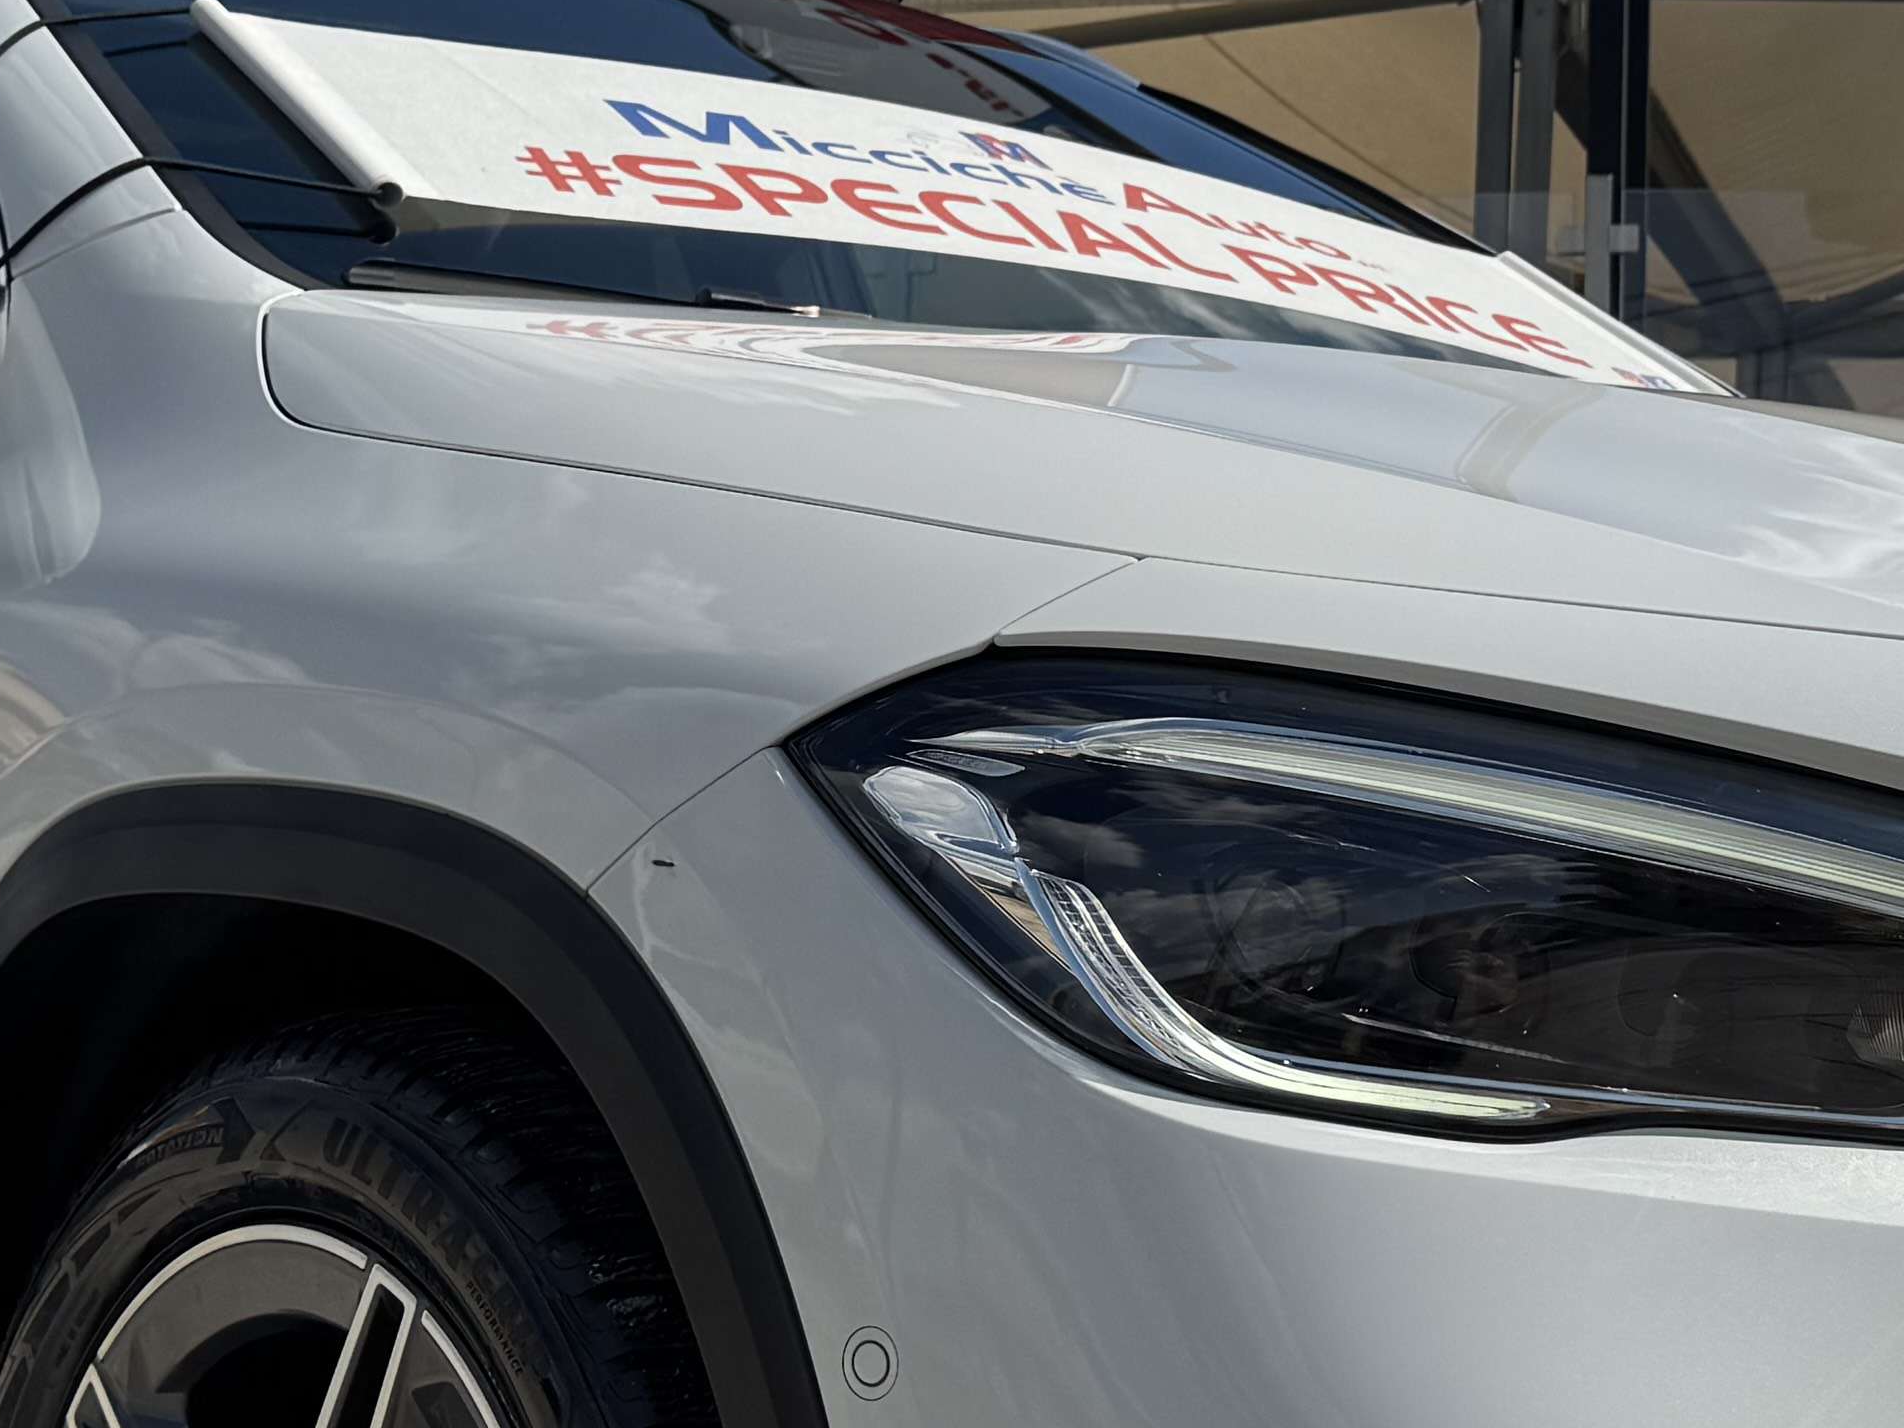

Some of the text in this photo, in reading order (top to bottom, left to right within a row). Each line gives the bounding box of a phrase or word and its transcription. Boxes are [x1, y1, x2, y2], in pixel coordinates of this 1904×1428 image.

[515, 144, 1594, 370] #SPECIAL PRICE
[603, 98, 1353, 261] Miccichè Auto
